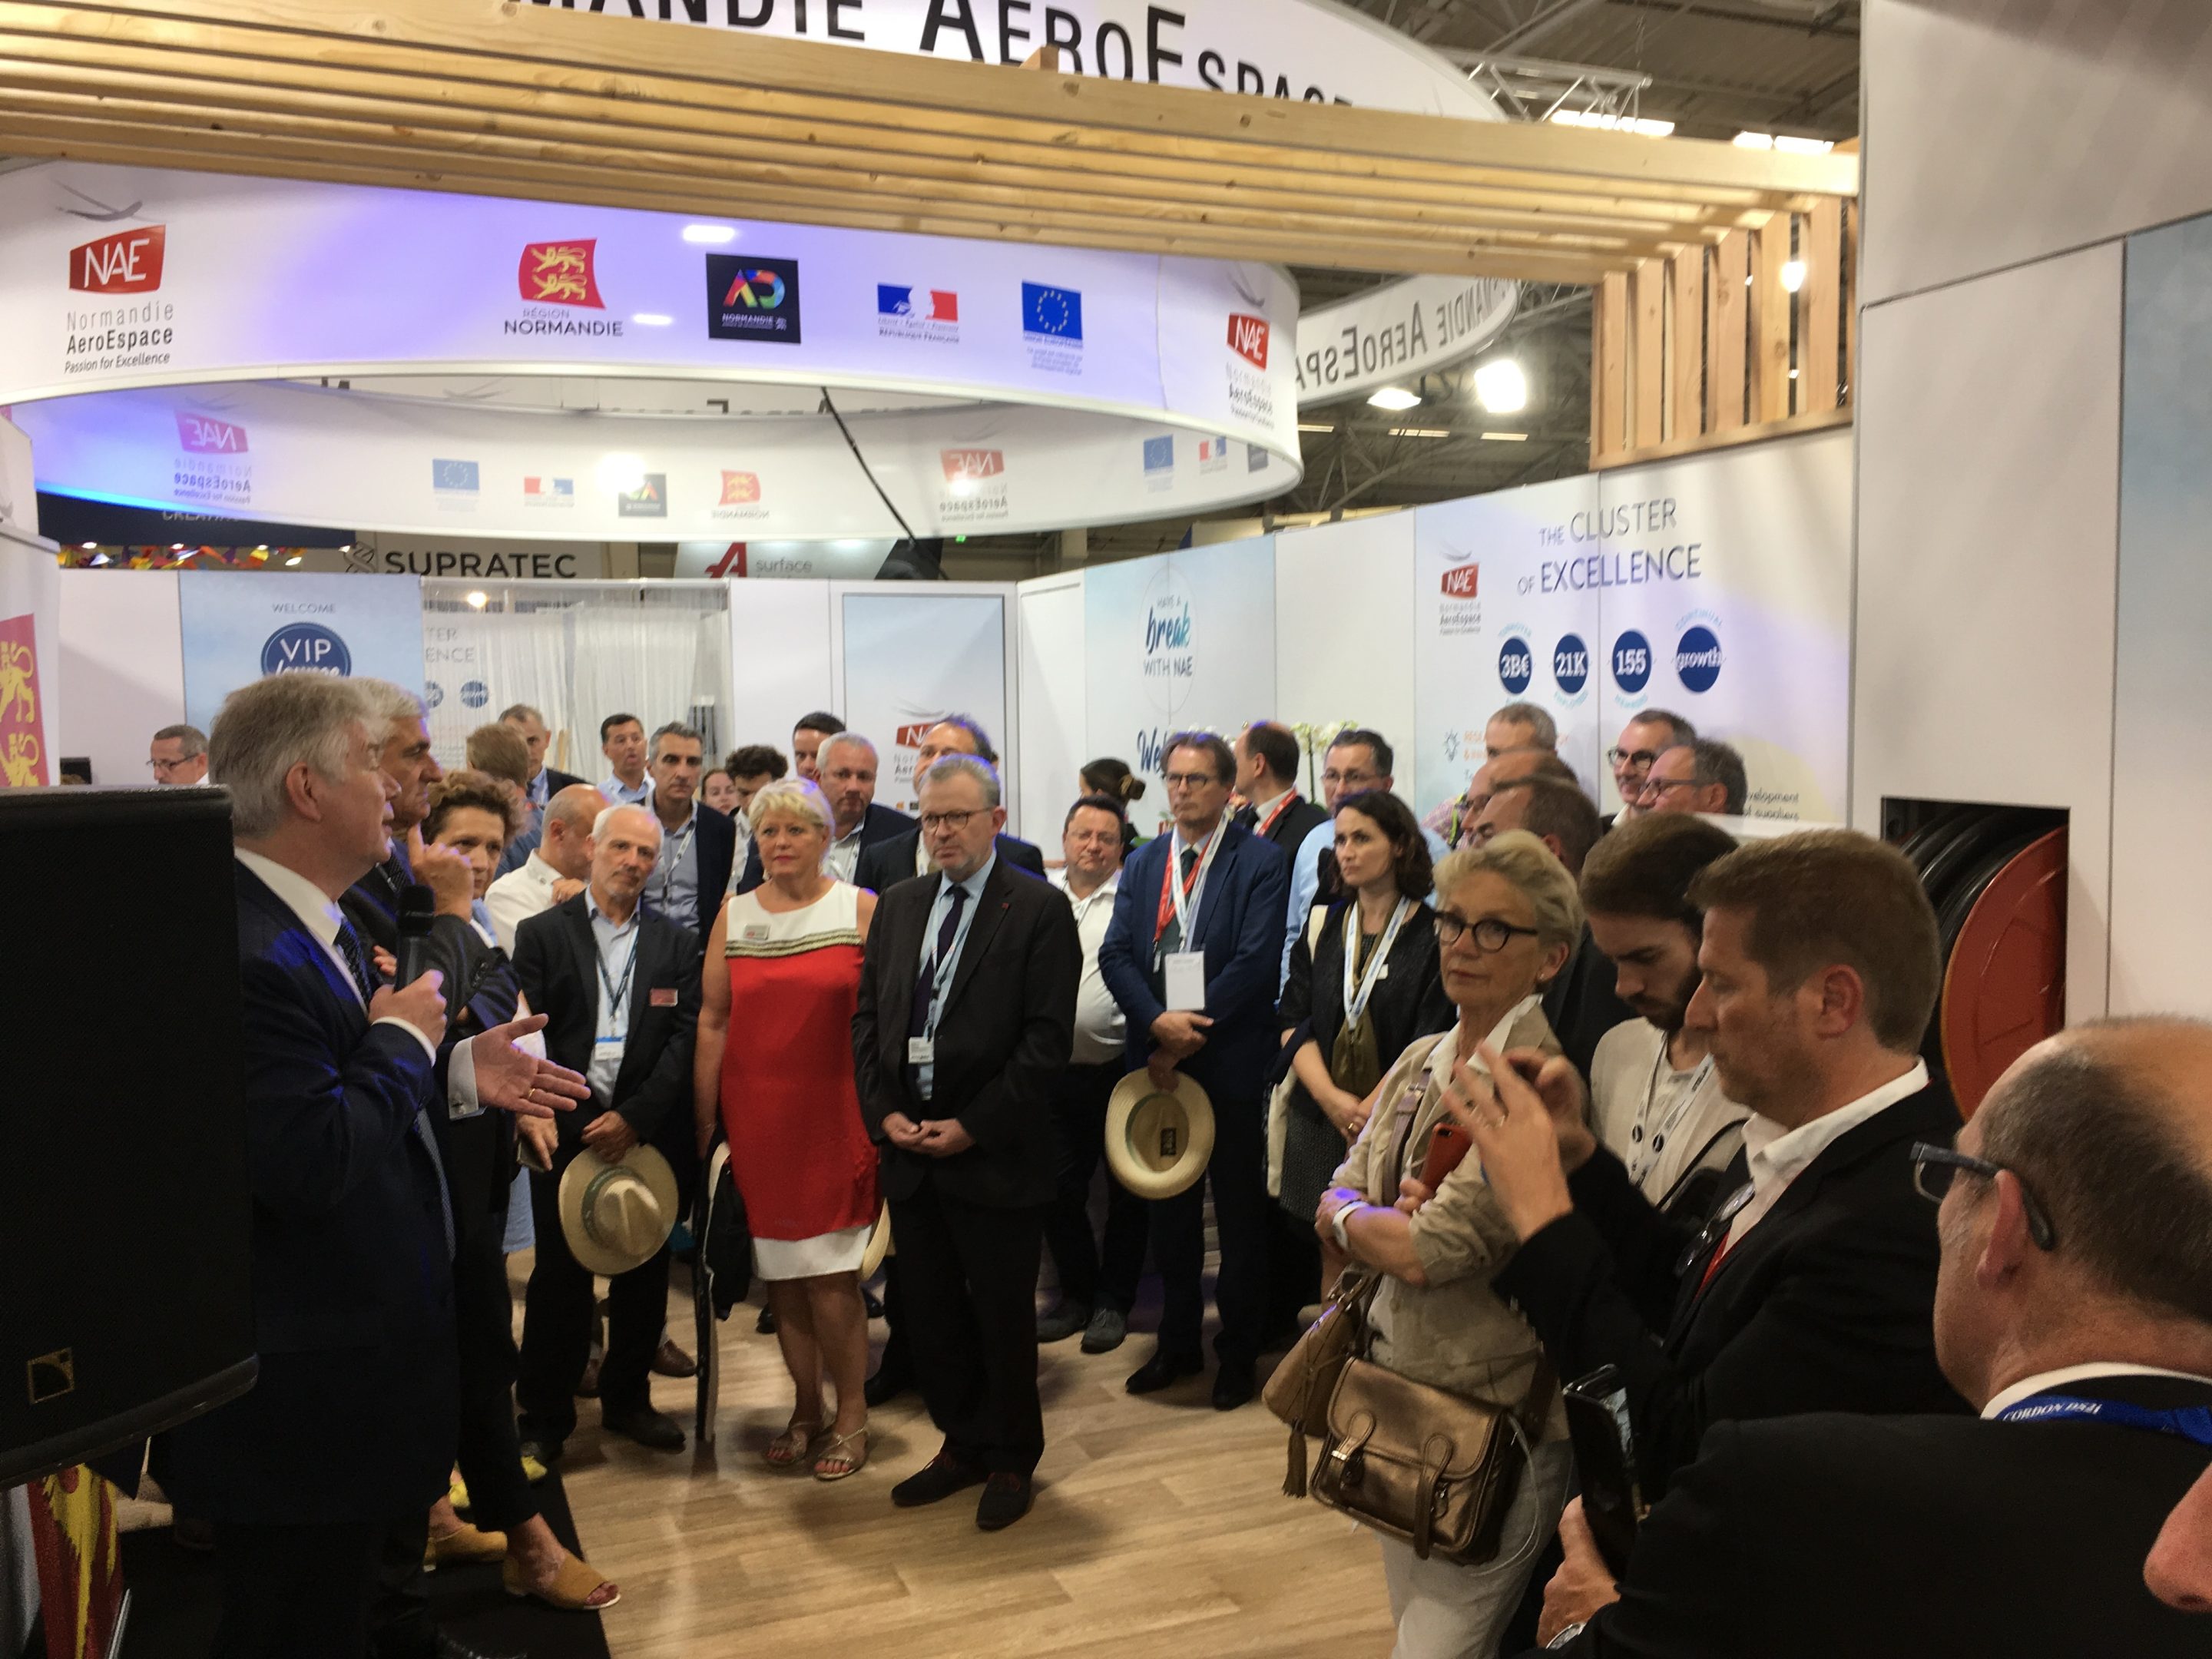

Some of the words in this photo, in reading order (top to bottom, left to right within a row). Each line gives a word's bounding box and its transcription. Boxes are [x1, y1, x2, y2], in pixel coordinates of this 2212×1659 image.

[84, 238, 150, 288] NAE
[67, 300, 174, 332] Normandie
[504, 320, 624, 336] NORMANDIE
[67, 326, 174, 355] AeroEspace
[1234, 314, 1266, 362] NAE
[64, 359, 98, 374] Passion
[100, 356, 114, 370] for
[115, 351, 171, 369] Excellence
[1538, 525, 1565, 547] THE
[1569, 498, 1677, 543] CLUSTER
[385, 550, 578, 578] SUPRATEC
[756, 556, 812, 573] surface
[1516, 576, 1535, 596] OF
[1541, 543, 1702, 594] EXCELLENCE
[1446, 568, 1475, 594] NAE
[272, 603, 336, 614] WELCOME
[1145, 601, 1191, 656] break
[280, 638, 332, 662] VIP
[1616, 648, 1647, 676] 155
[1676, 646, 1722, 671] growth
[1143, 657, 1170, 677] WITH
[1174, 655, 1193, 677] NAE
[1501, 654, 1530, 679] 3B€
[1555, 651, 1586, 677] 21K
